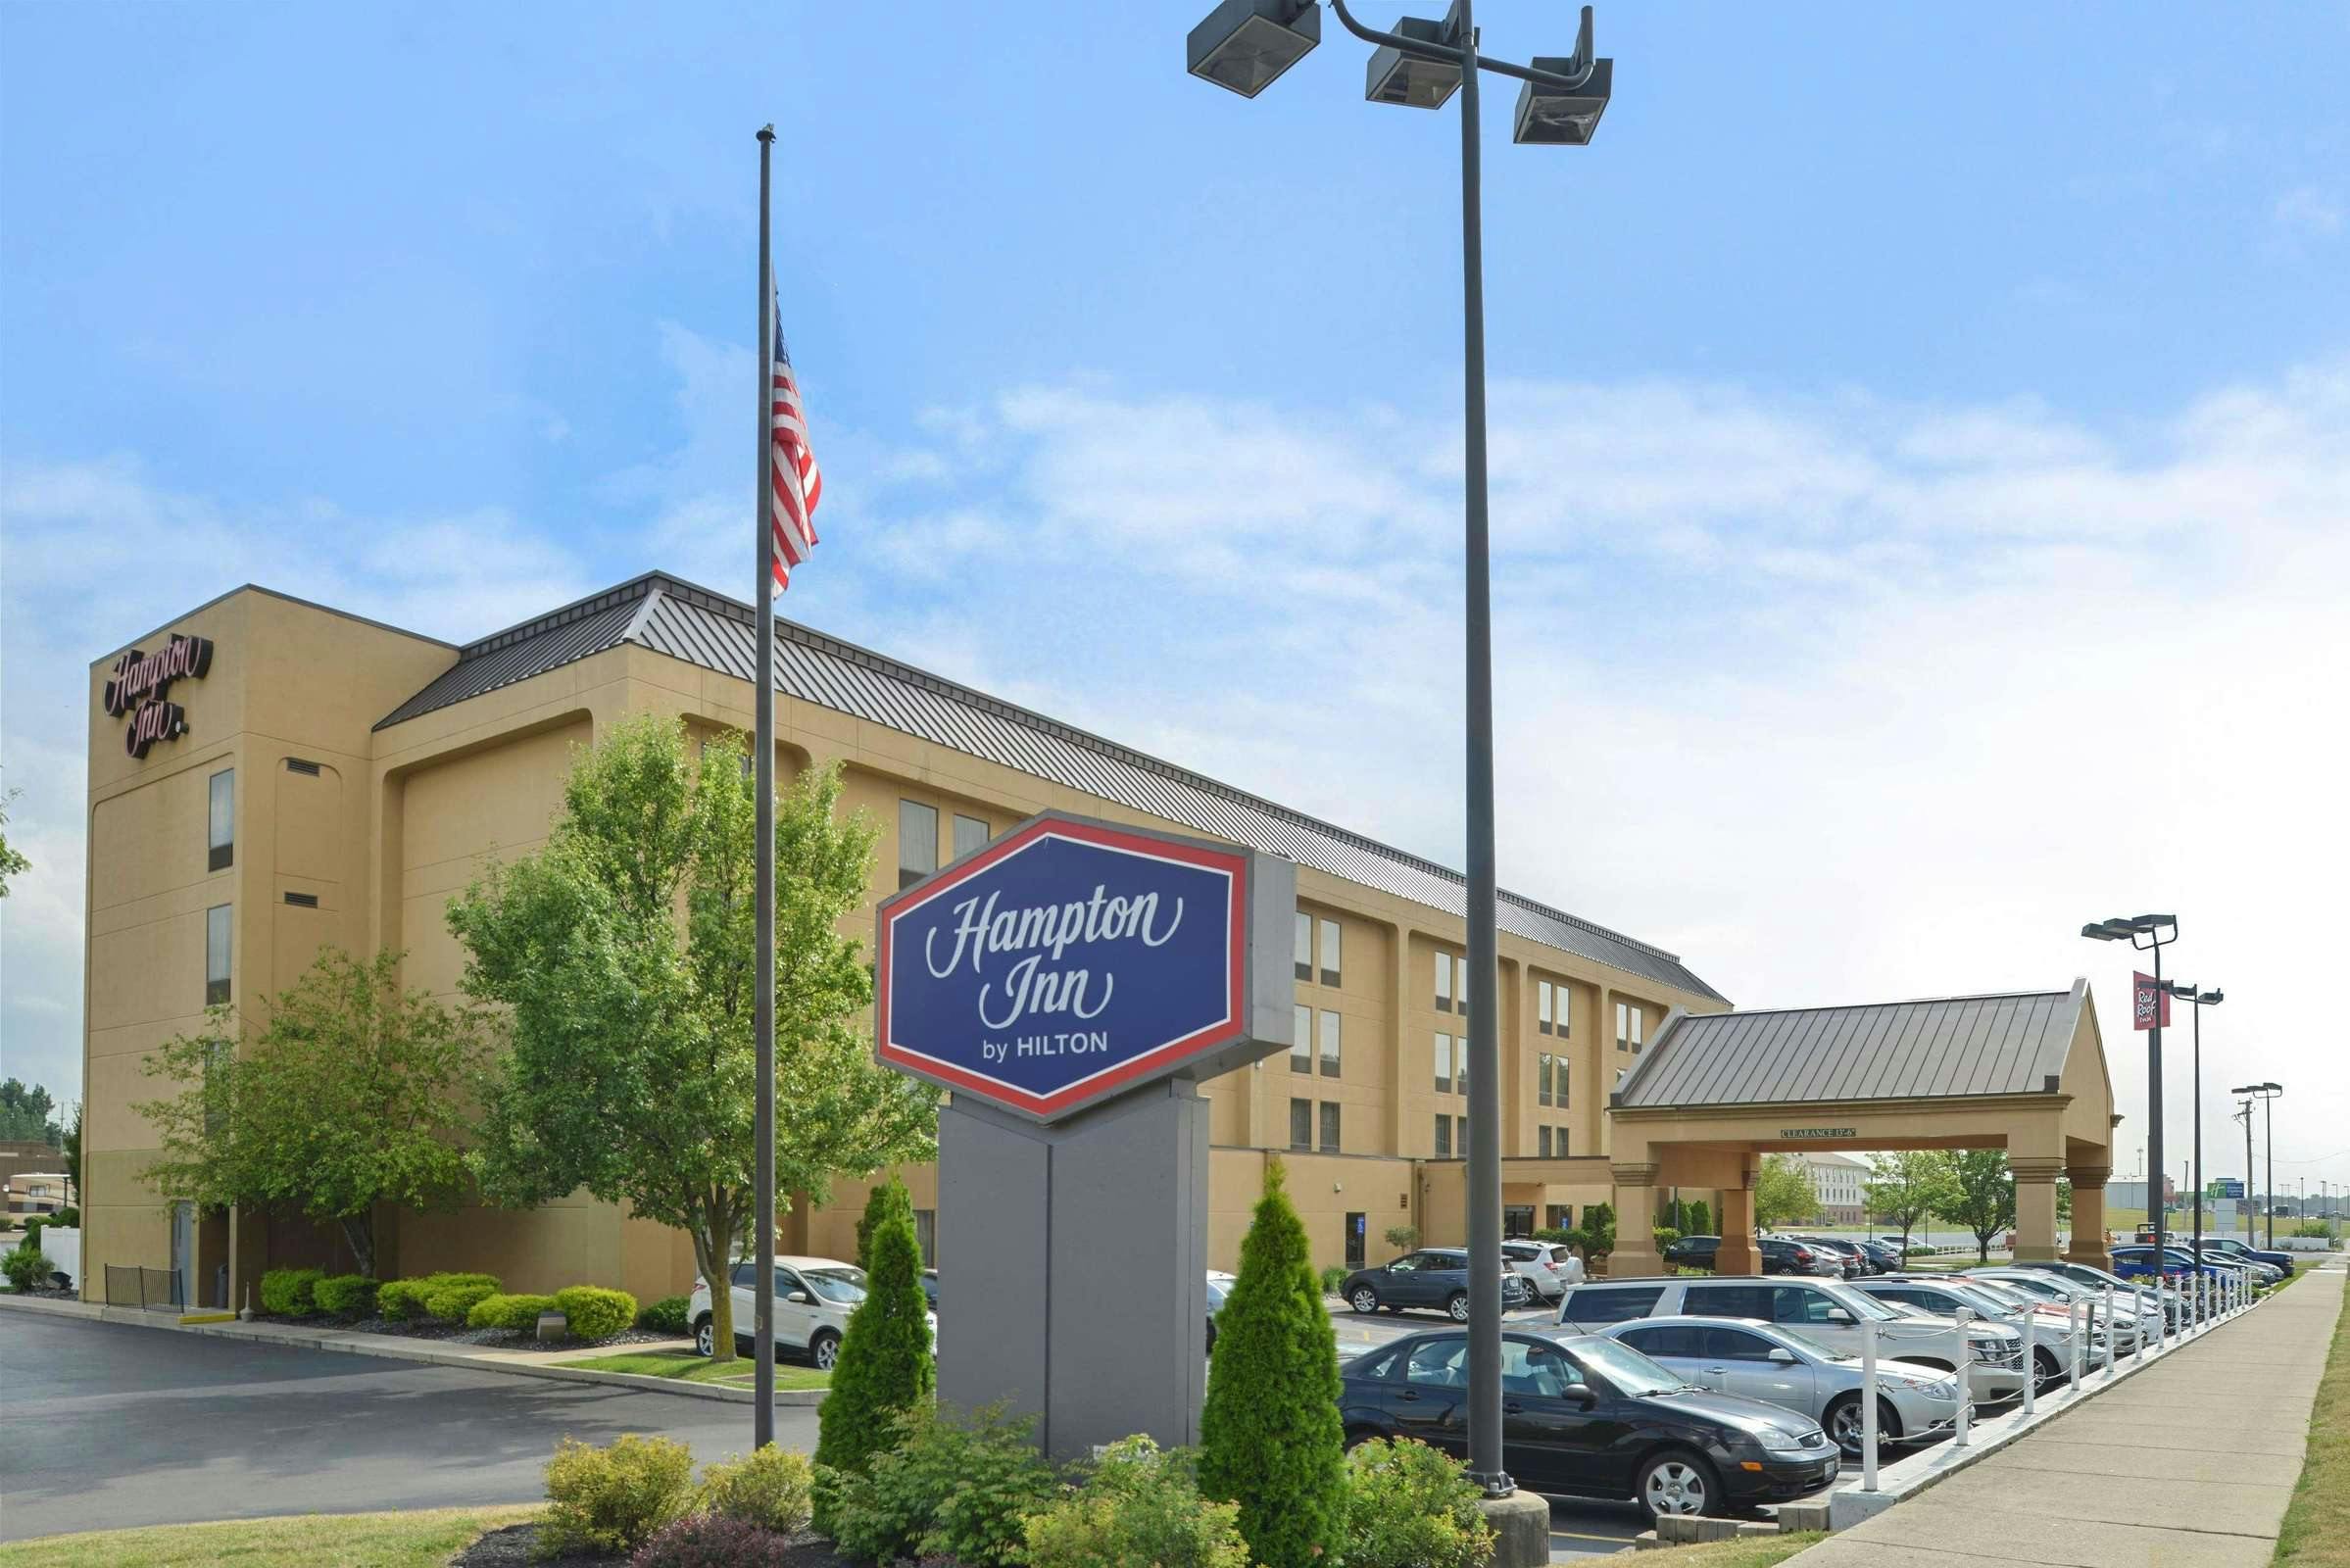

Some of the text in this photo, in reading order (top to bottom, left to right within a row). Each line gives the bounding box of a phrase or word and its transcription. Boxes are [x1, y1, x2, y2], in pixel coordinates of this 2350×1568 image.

[103, 633, 209, 717] Hampton
[124, 699, 180, 760] Inn
[925, 884, 1184, 979] Hampton
[978, 955, 1114, 1030] Inn
[2137, 1001, 2157, 1017] Roof
[2138, 991, 2154, 1004] Red
[983, 1031, 1108, 1064] by HILTON
[1782, 1128, 1834, 1138] CLEARANCE
